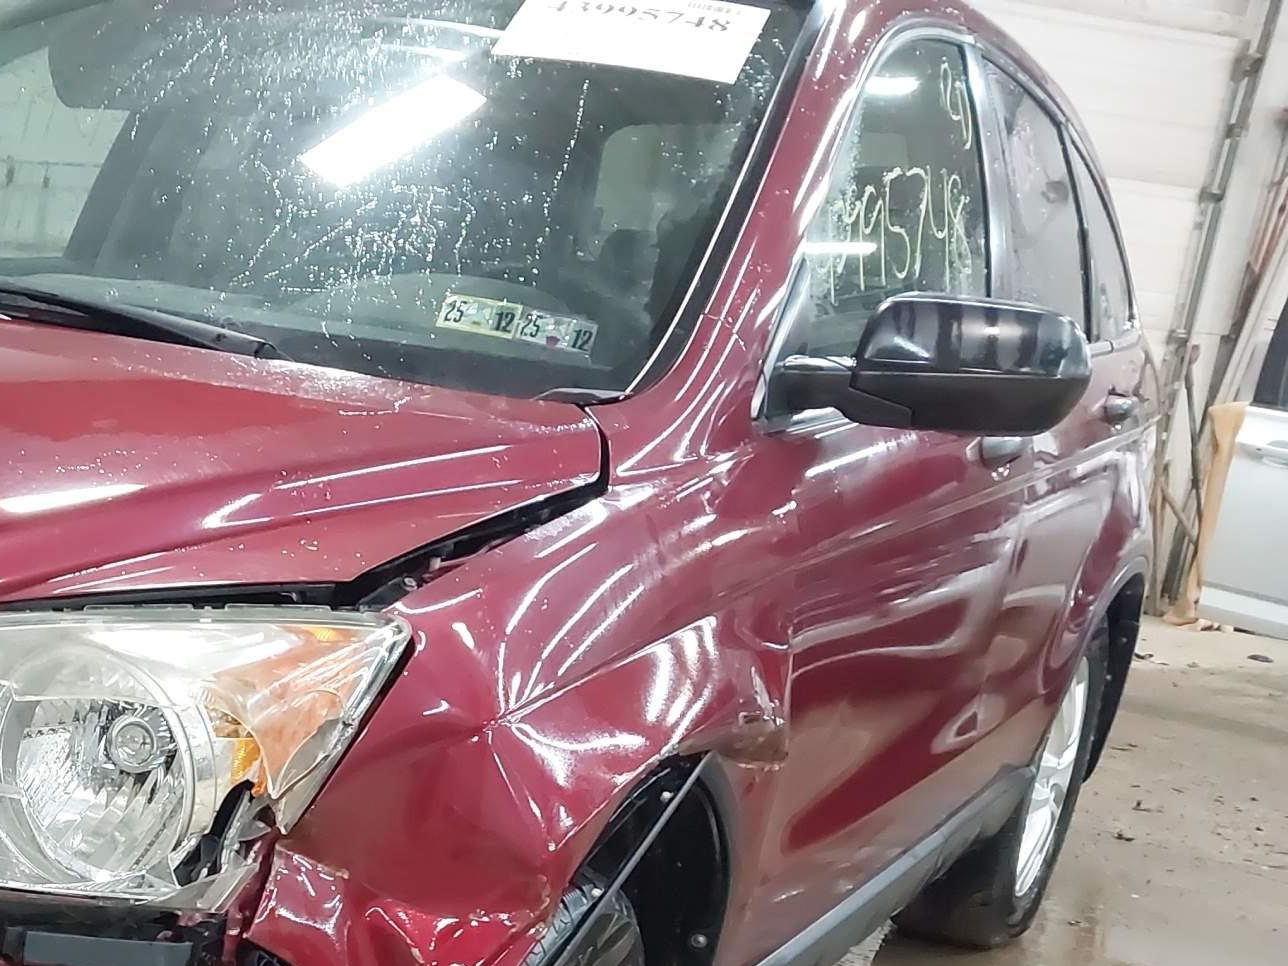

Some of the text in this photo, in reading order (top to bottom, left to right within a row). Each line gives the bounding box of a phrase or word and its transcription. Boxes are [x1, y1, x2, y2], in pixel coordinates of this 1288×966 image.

[444, 300, 516, 333] 25 12
[520, 313, 593, 351] 25 12
